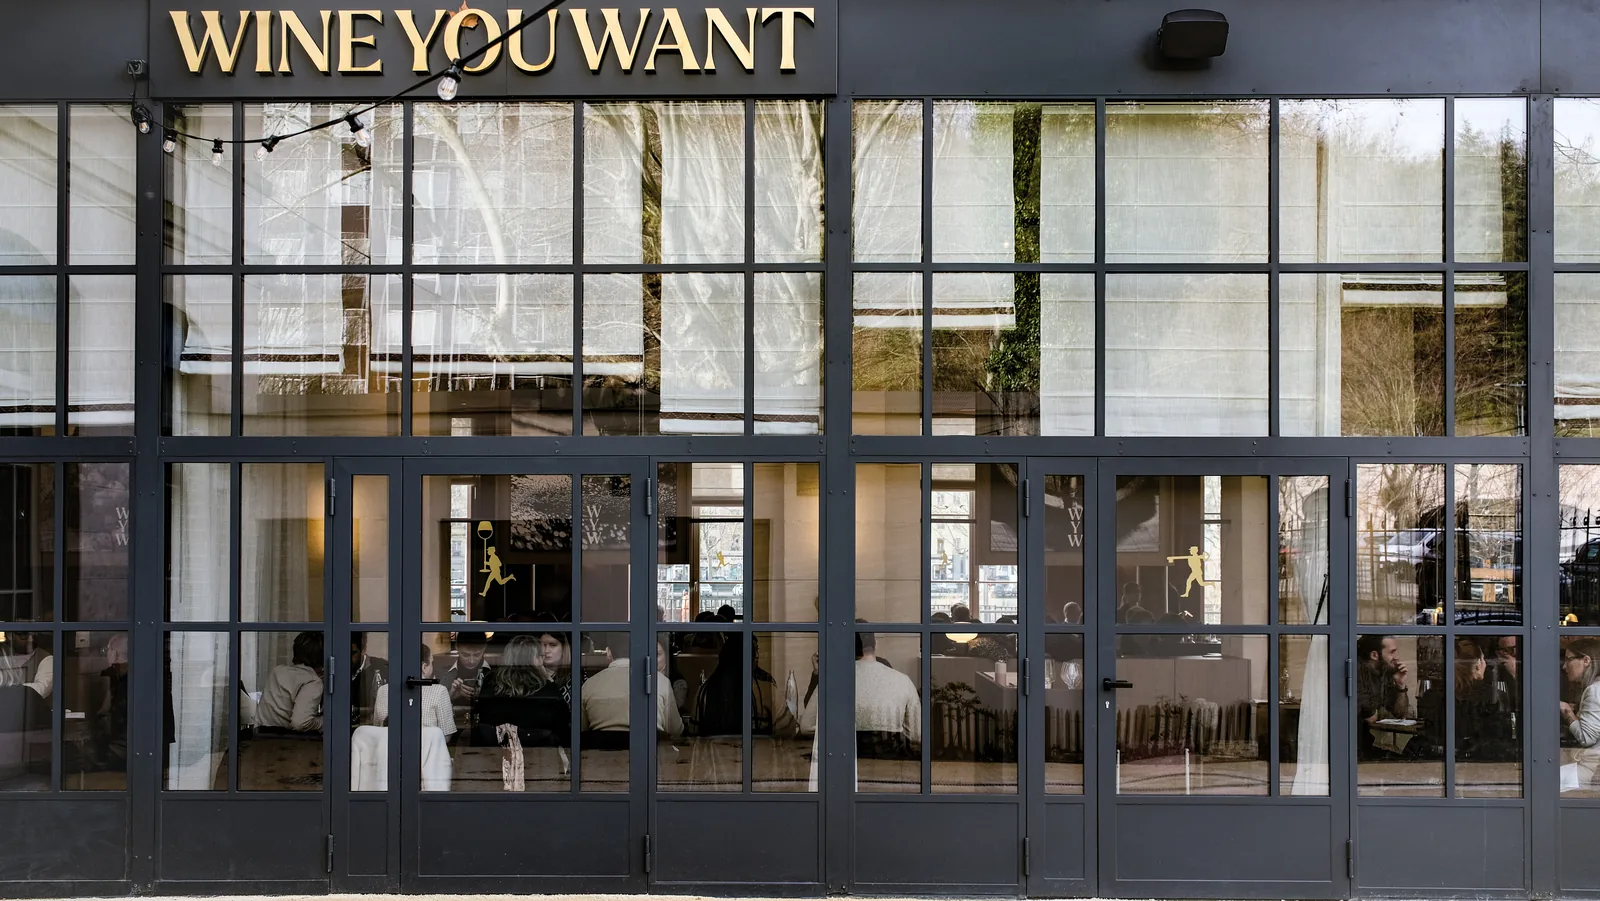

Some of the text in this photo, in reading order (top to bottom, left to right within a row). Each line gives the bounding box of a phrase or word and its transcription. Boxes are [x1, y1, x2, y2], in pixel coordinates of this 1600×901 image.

[169, 7, 815, 74] WINE YOU WANT
[115, 506, 130, 546] WYW
[586, 505, 602, 545] WYW
[1067, 507, 1083, 547] WYW
